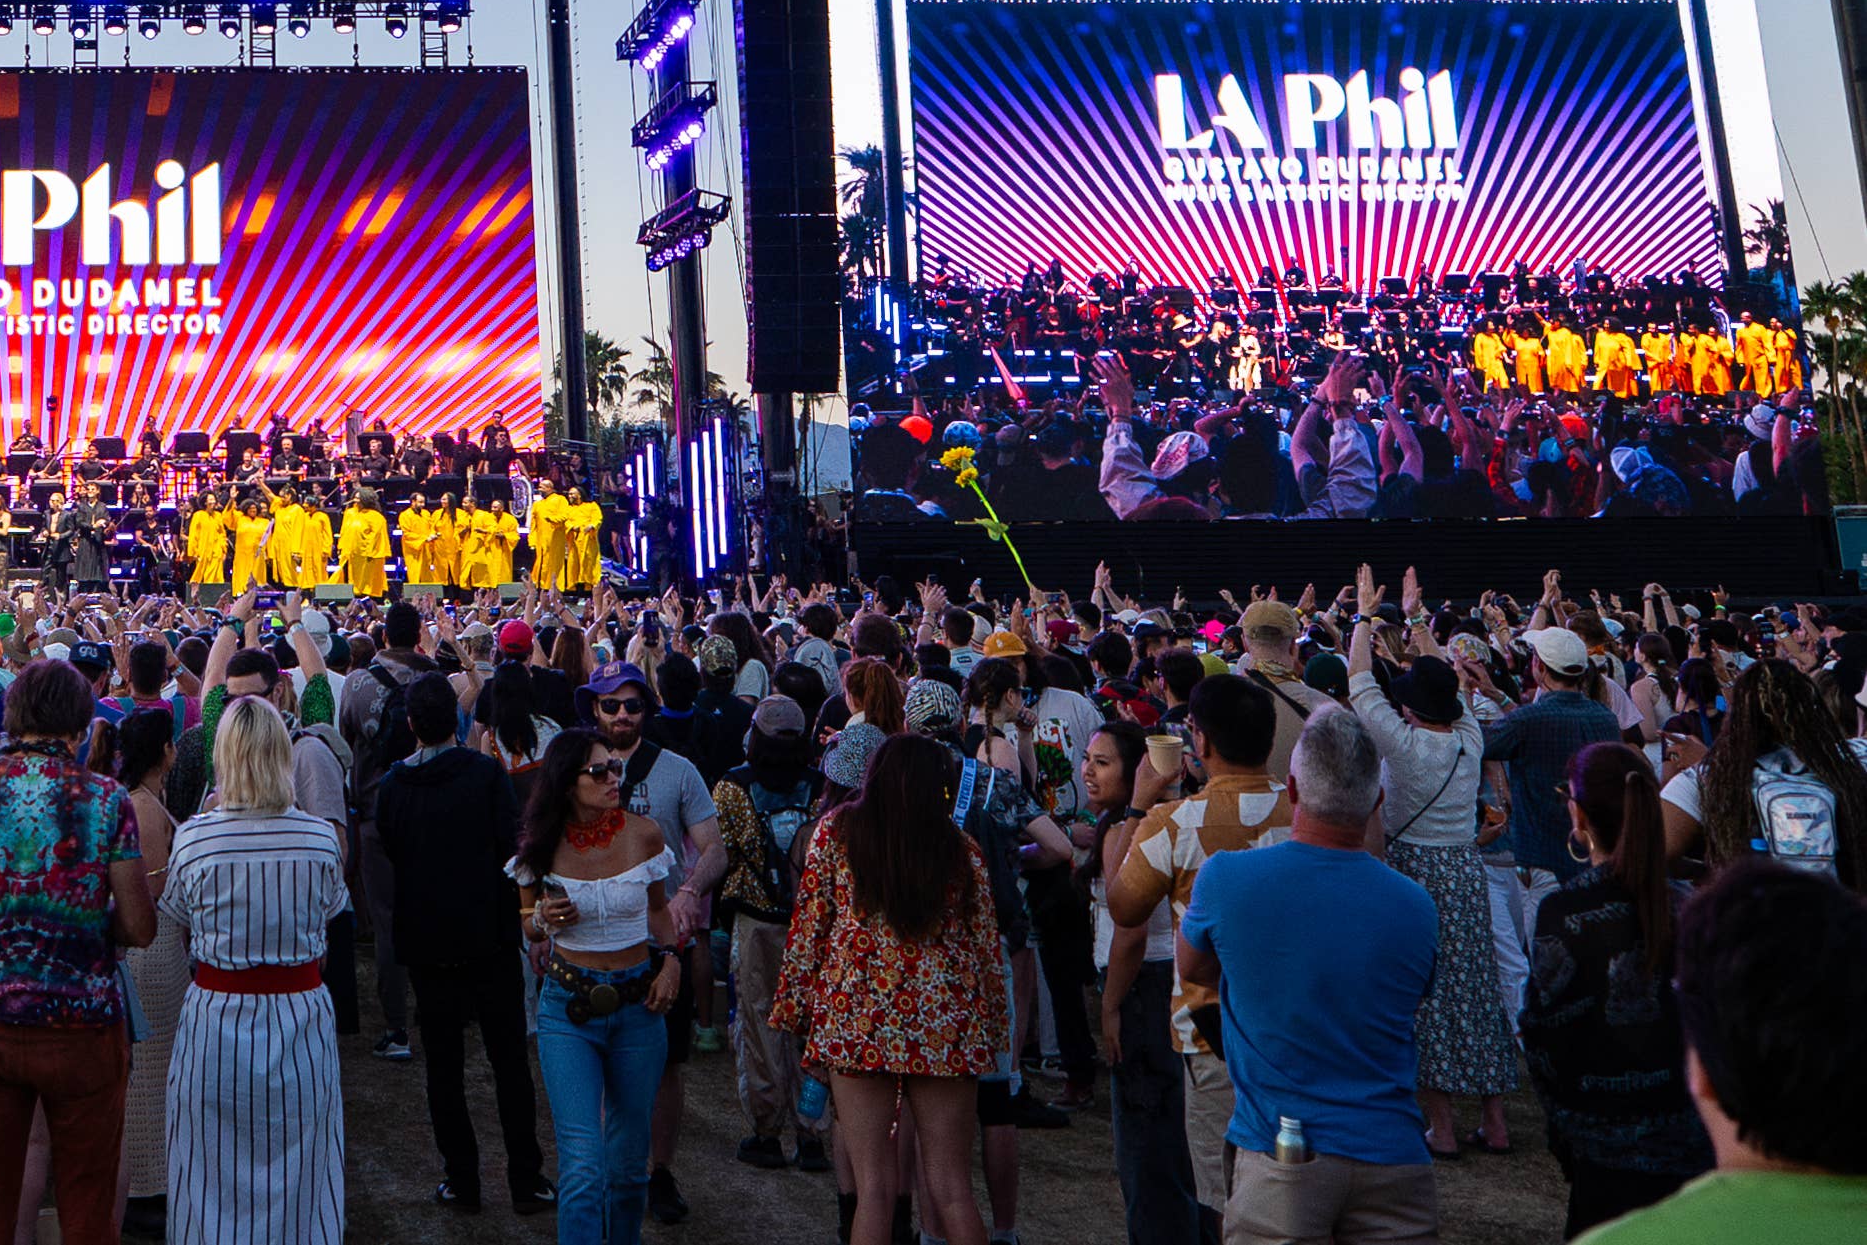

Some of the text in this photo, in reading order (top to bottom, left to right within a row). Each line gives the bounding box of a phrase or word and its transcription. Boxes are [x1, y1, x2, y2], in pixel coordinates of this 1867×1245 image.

[1155, 66, 1459, 149] LA Phil
[1162, 157, 1463, 181] GUSTAVO DUDAMEL
[1, 159, 222, 266] Phil
[33, 278, 222, 308] DUDAMEL
[88, 314, 222, 336] DIRECTOR
